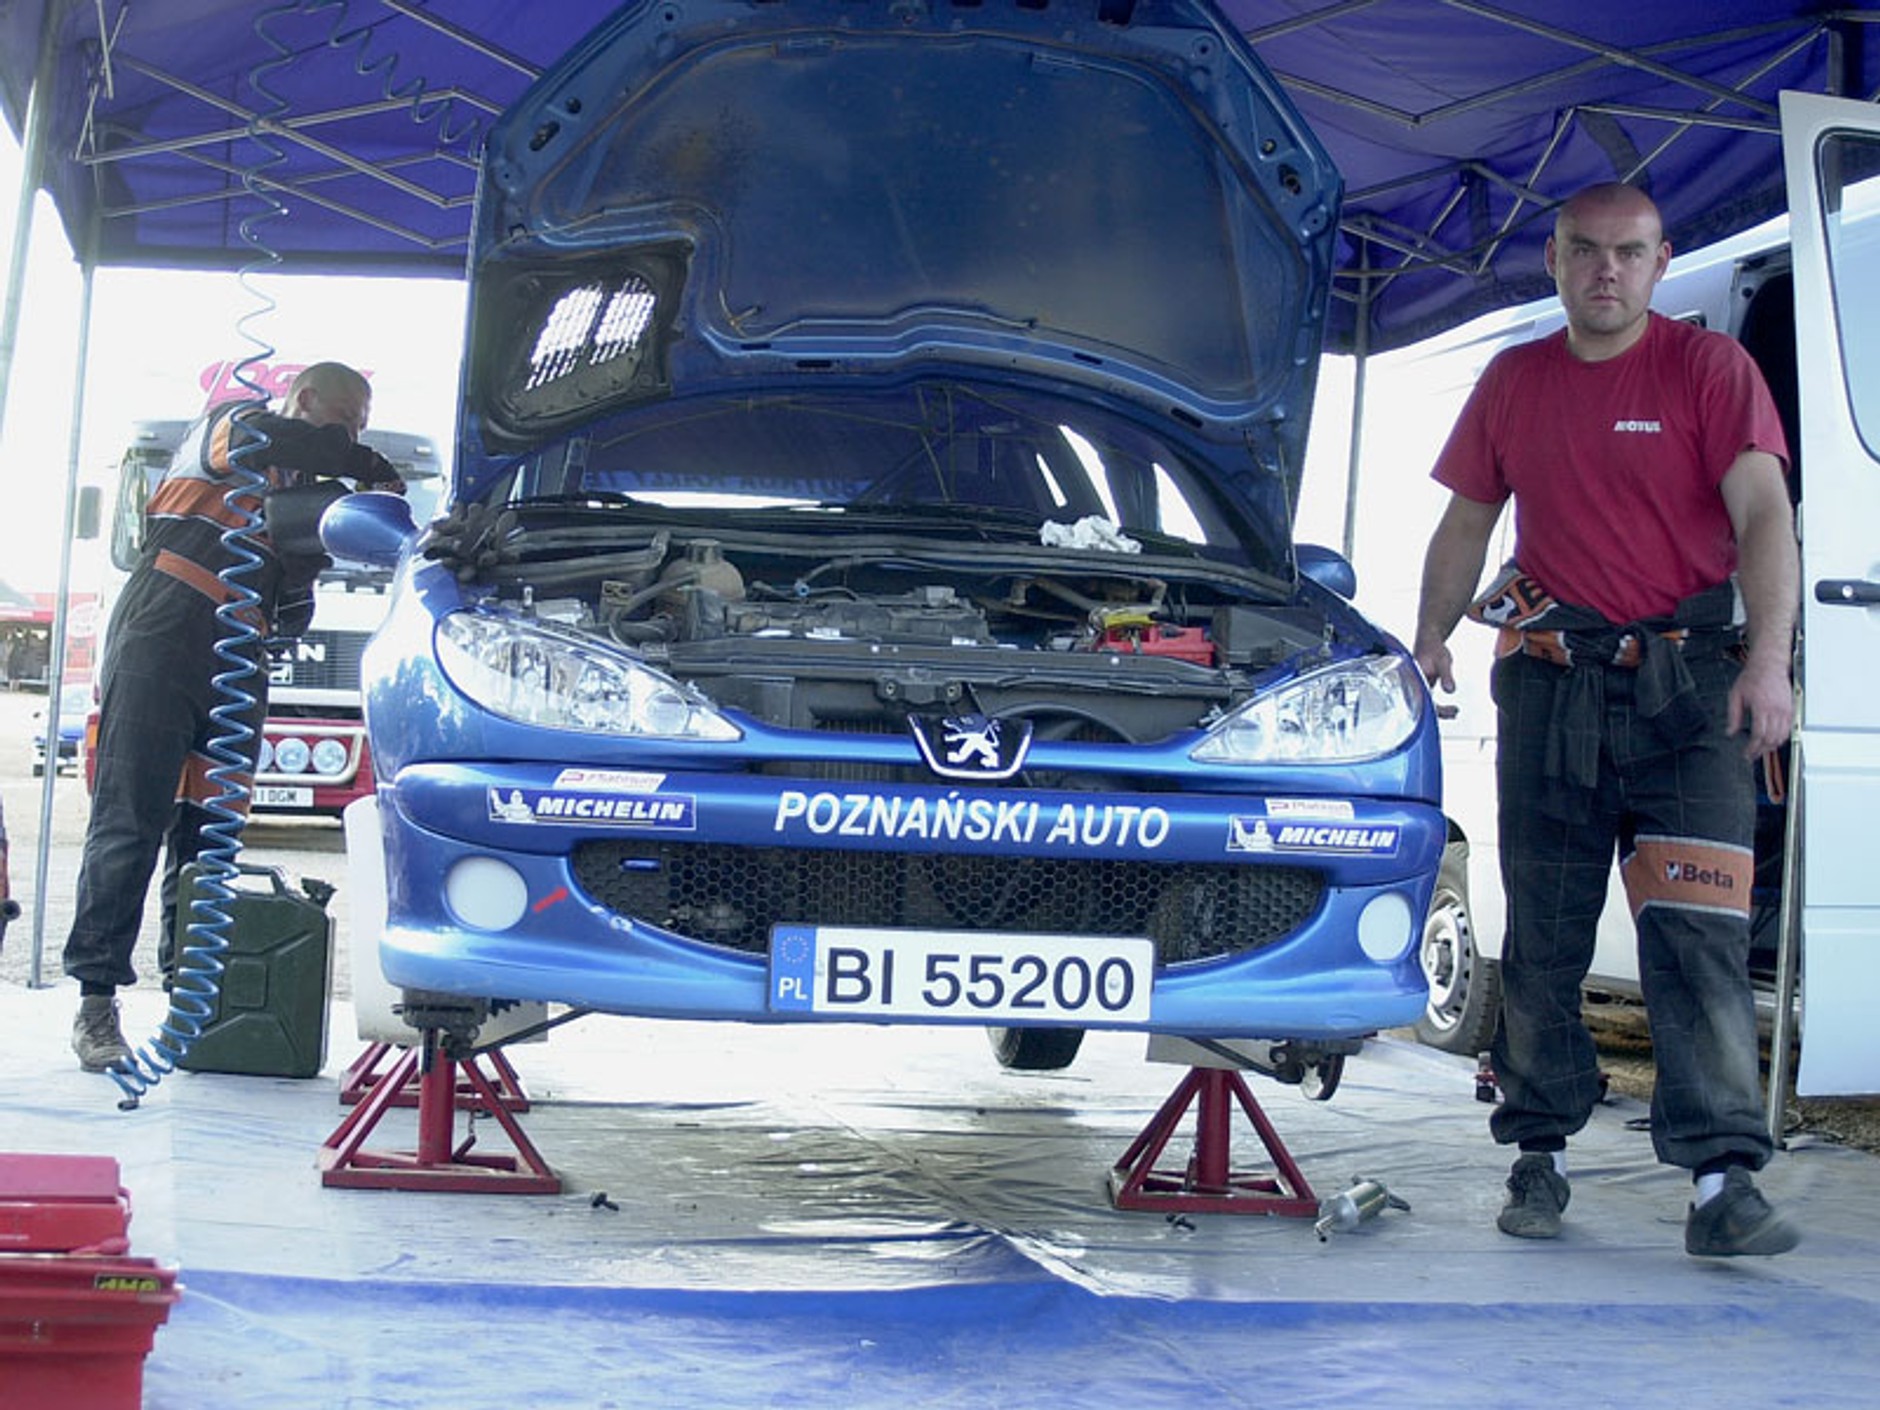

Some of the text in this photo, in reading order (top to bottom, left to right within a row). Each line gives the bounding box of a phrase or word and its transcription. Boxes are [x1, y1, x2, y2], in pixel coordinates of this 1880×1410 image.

[536, 795, 686, 821] MICHELIN
[774, 790, 1170, 849] POZNAŃSKI AUTO
[1277, 826, 1396, 848] MICHELIN
[1682, 862, 1734, 890] Beta
[778, 976, 808, 1001] PL
[825, 946, 1136, 1012] BI 55200
